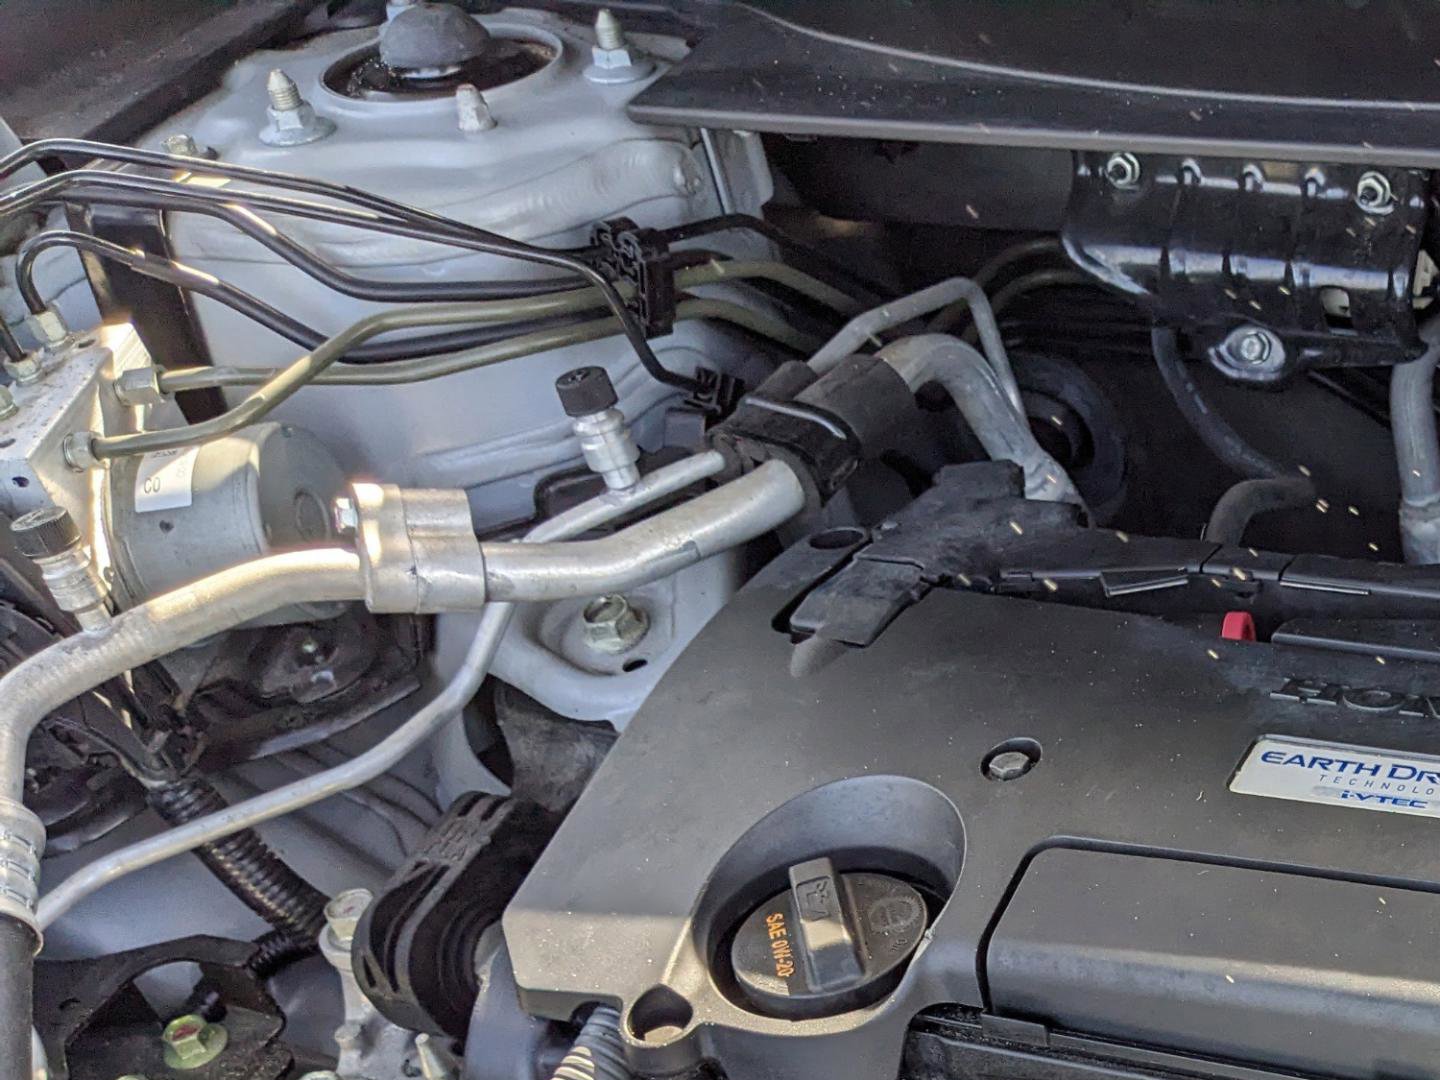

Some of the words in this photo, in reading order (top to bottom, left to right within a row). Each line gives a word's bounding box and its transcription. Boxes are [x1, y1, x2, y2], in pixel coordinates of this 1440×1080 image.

[1261, 750, 1382, 777] EARTH
[1340, 790, 1429, 809] i-VTEC
[766, 912, 787, 940] SAE
[771, 940, 796, 978] 0W-20
